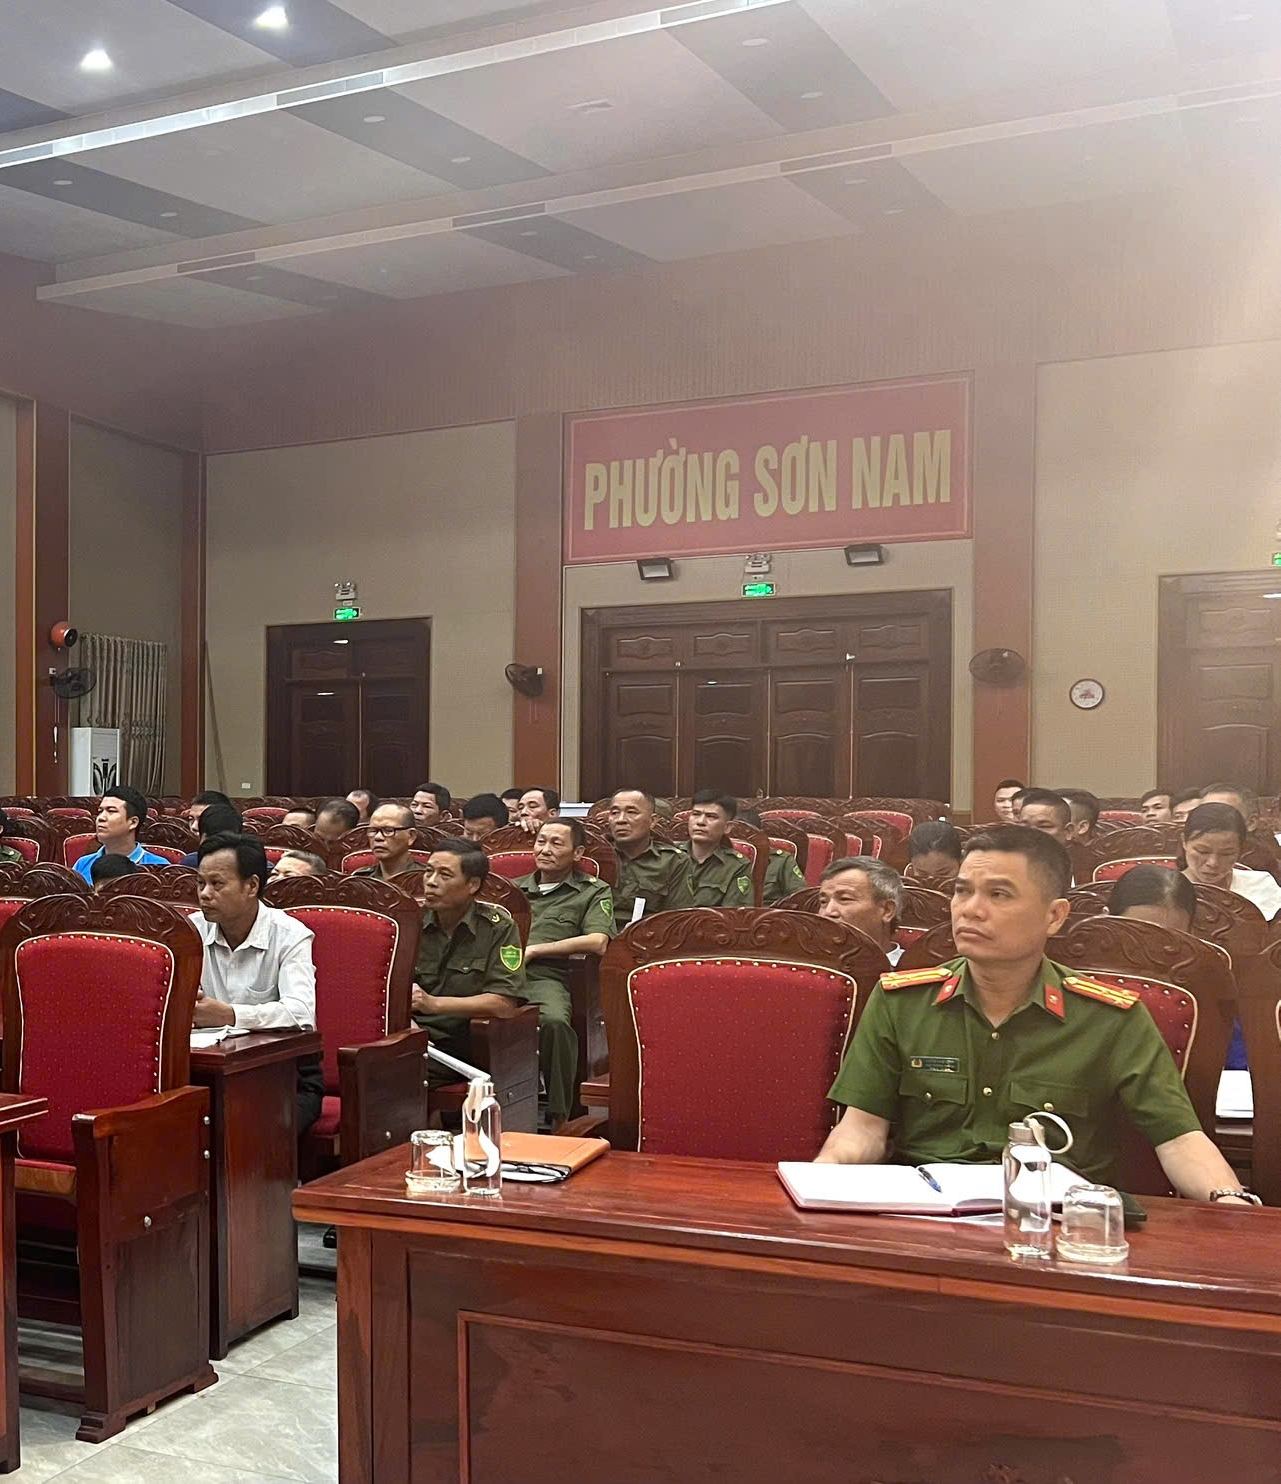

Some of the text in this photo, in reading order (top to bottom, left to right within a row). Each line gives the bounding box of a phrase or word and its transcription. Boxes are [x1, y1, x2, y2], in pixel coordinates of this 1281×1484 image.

[584, 429, 952, 530] PHƯỜNG SƠN NAM
